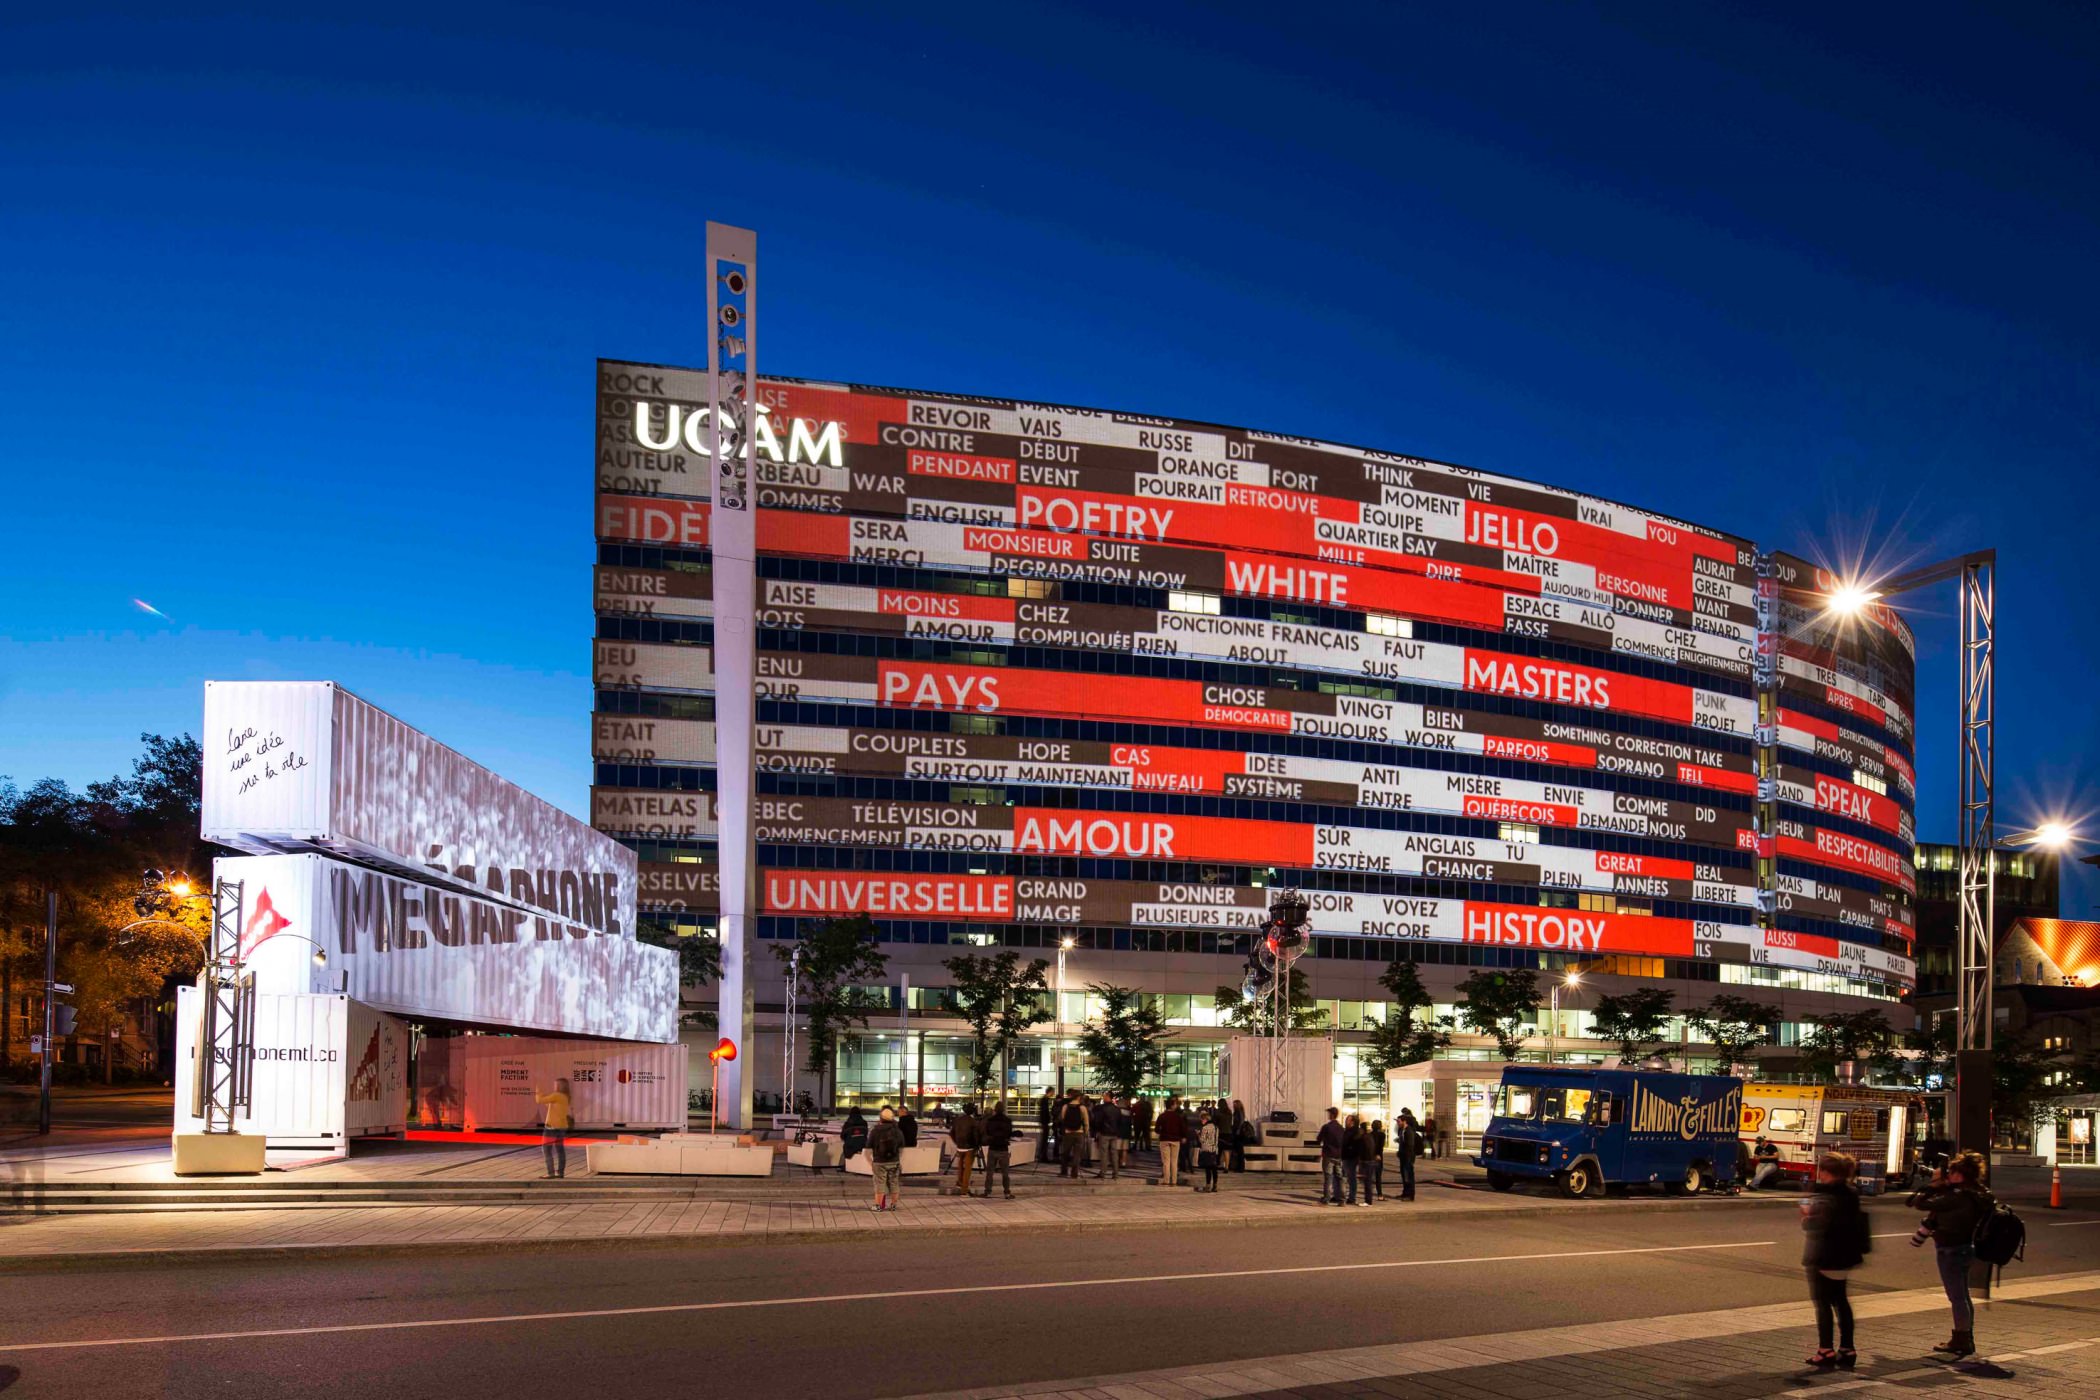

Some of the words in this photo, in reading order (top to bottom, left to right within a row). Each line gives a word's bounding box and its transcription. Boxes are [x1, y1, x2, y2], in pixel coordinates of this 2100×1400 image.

[602, 372, 664, 395] ROCK
[912, 405, 991, 430] REVOIR
[1019, 416, 1062, 437] VAIS
[882, 427, 974, 452] CONTRE
[1139, 431, 1192, 453] RUSSE
[1229, 441, 1256, 460] DIT
[601, 450, 687, 473] AUTEUR
[1019, 438, 1080, 464] DÉBUT
[911, 454, 1011, 480] PENDANT
[1019, 465, 1080, 488] EVENT
[1161, 457, 1238, 481] ORANGE
[1363, 463, 1414, 487] THINK
[854, 472, 906, 494] WAR
[1139, 478, 1223, 502] POURRAIT
[1272, 470, 1319, 492] FORT
[1467, 482, 1491, 502] VIE
[1229, 489, 1319, 515] RETROUVE
[1385, 489, 1460, 517] MOMENT
[911, 503, 1003, 528] ENGLISH
[1021, 495, 1174, 543] POETRY
[1363, 505, 1423, 533] ÉQUIPE
[1580, 505, 1611, 528] VRAI
[854, 520, 908, 542] SERA
[1318, 522, 1399, 549] QUARTIER
[1467, 510, 1559, 556] JELLO
[1648, 524, 1677, 545] YOU
[968, 531, 1073, 557] MONSIEUR
[1091, 542, 1140, 563] SUITE
[1405, 536, 1438, 557] SAY
[853, 545, 924, 567] MERCI
[1318, 545, 1365, 567] MILLE
[1506, 554, 1559, 577] MAÎTRE
[993, 557, 1131, 586] DEGRADATION
[1138, 567, 1187, 590] NOW
[1426, 562, 1463, 582] DIRE
[1694, 557, 1736, 581] AURAIT
[600, 571, 667, 594] ENTRE
[1229, 561, 1349, 607] WHITE
[1599, 573, 1668, 604] PERSONNE
[1694, 578, 1732, 600] GREAT
[771, 585, 816, 606] AISE
[883, 593, 960, 616] MOINS
[1018, 604, 1070, 624] CHEZ
[1506, 596, 1560, 619] ESPACE
[1615, 597, 1674, 626] DONNER
[1694, 597, 1730, 619] WANT
[1505, 617, 1549, 639] FASSE
[1580, 609, 1615, 630] ALLÔ
[1694, 616, 1741, 640] RENARD
[911, 620, 994, 642] AMOUR
[1018, 627, 1131, 651] COMPLIQUÉE
[1161, 615, 1265, 638] FONCTIONNE
[1272, 625, 1359, 652] FRANÇAIS
[1665, 628, 1697, 649] CHEZ
[598, 647, 636, 667] JEU
[1137, 637, 1177, 656] RIEN
[1227, 645, 1288, 665] ABOUT
[1384, 640, 1425, 662] FAUT
[1615, 636, 1676, 661] COMMENCÉ
[1361, 660, 1399, 680] SUIS
[1679, 650, 1749, 675] ENLIGHTENMENTS
[884, 671, 1000, 713] PAYS
[1468, 657, 1610, 709] MASTERS
[1205, 686, 1266, 708] CHOSE
[1695, 692, 1727, 712] PUNK
[1868, 688, 1887, 710] TARD
[1205, 706, 1287, 728] DÉMOCRATIE
[1340, 699, 1393, 721] VINGT
[1426, 710, 1464, 730] BIEN
[600, 716, 656, 742] ÉTAIT
[1294, 717, 1388, 743] TOUJOURS
[1694, 713, 1736, 734] PROJET
[853, 734, 967, 756] COUPLETS
[1405, 729, 1456, 751] WORK
[1486, 739, 1549, 762] PARFOIS
[1543, 723, 1611, 747] SOMETHING
[1615, 737, 1692, 762] CORRECTION
[1695, 750, 1723, 768] TAKE
[1838, 727, 1885, 755] DESTRUCTIVENESS
[1019, 743, 1071, 761] HOPE
[1114, 747, 1150, 766] CAS
[1816, 740, 1853, 765] PROPOS
[909, 761, 1008, 783] SURTOUT
[1249, 755, 1286, 775] IDÉE
[1597, 754, 1664, 779] SOPRANO
[1679, 767, 1703, 785] TELL
[1859, 755, 1885, 777] SERVIR
[1018, 766, 1130, 788] MAINTENANT
[1137, 773, 1203, 793] NIVEAU
[1226, 775, 1303, 800] SYSTÈME
[1362, 767, 1400, 786] ANTI
[596, 796, 697, 818] MATELAS
[1361, 790, 1411, 810] ENTRE
[1544, 786, 1584, 806] ENVIE
[1615, 796, 1669, 817] COMME
[1817, 780, 1871, 825] SPEAK
[852, 802, 977, 827] TÉLÉVISION
[1467, 799, 1554, 823] QUÉBÉCOIS
[1695, 806, 1716, 823] DID
[1580, 812, 1645, 833] DEMANDE
[1649, 820, 1686, 841] NOUS
[911, 831, 1002, 851] PARDON
[1019, 818, 1175, 858] AMOUR
[1318, 825, 1351, 847] SÛR
[1405, 836, 1475, 858] ANGLAIS
[1316, 850, 1391, 872] SYSTÈME
[1505, 844, 1524, 861] TU
[1598, 854, 1642, 873] GREAT
[1817, 832, 1900, 877] RESPECTABILITÉ
[1424, 859, 1494, 881] CHANCE
[1543, 870, 1582, 888] PLEIN
[1695, 865, 1723, 882] REAL
[770, 878, 1010, 913] UNIVERSELLE
[1017, 880, 1087, 899] GRAND
[1159, 885, 1235, 904] DONNER
[1615, 876, 1669, 898] ANNÉES
[1695, 885, 1737, 904] LIBERTÉ
[1817, 885, 1841, 904] PLAN
[1017, 905, 1081, 922] IMAGE
[1136, 908, 1219, 924] PLUSIEURS
[1383, 899, 1438, 918] VOYEZ
[1361, 921, 1430, 939] ENCORE
[1468, 911, 1606, 951] HISTORY
[1695, 923, 1722, 939] FOIS
[1766, 929, 1797, 947] AUSSI
[1695, 943, 1712, 958] ILS
[1752, 948, 1769, 962] VIE
[1840, 944, 1867, 964] JAUNE
[1817, 959, 1853, 976] DEVANT
[1631, 1079, 1681, 1132] LANDRY
[1680, 1096, 1700, 1141] &
[1699, 1086, 1741, 1132] FILLES
